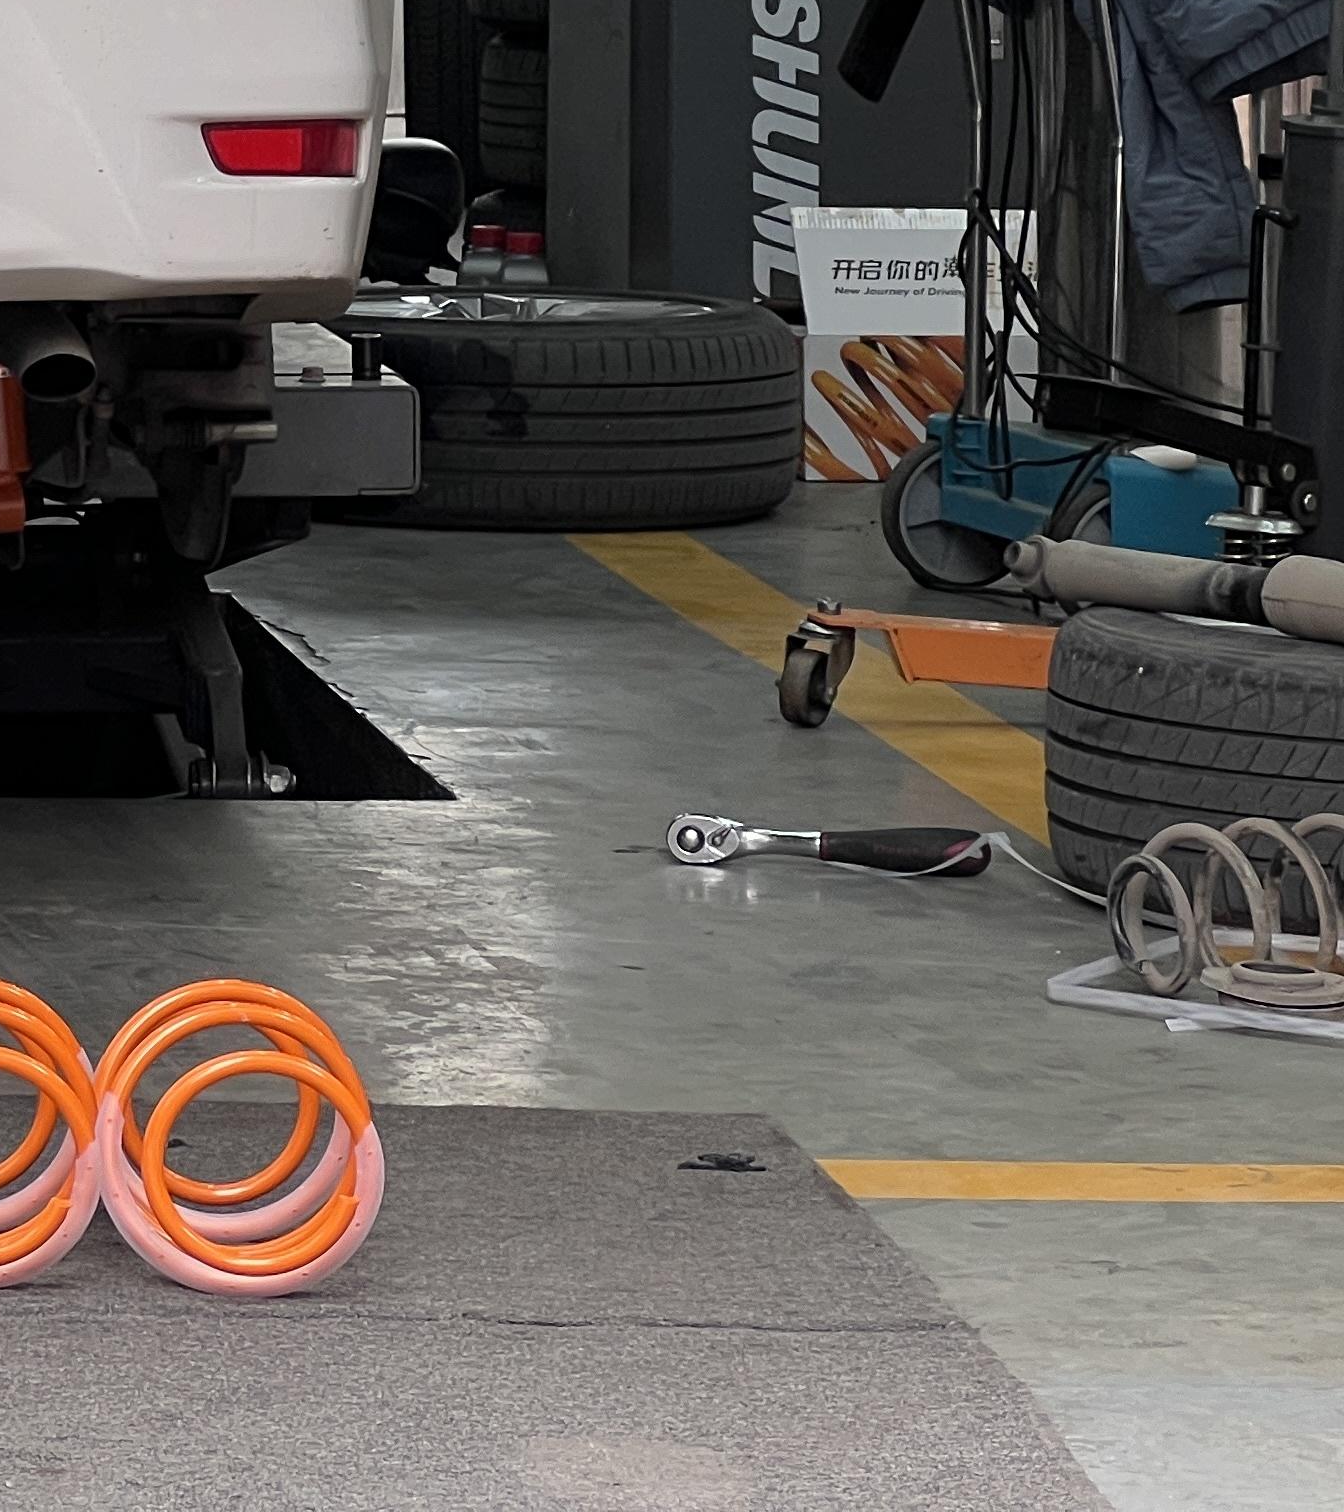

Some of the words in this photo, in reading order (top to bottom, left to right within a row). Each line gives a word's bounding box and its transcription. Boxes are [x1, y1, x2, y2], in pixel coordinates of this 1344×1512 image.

[835, 287, 860, 295] New
[864, 287, 909, 297] Journey
[913, 287, 924, 296] of
